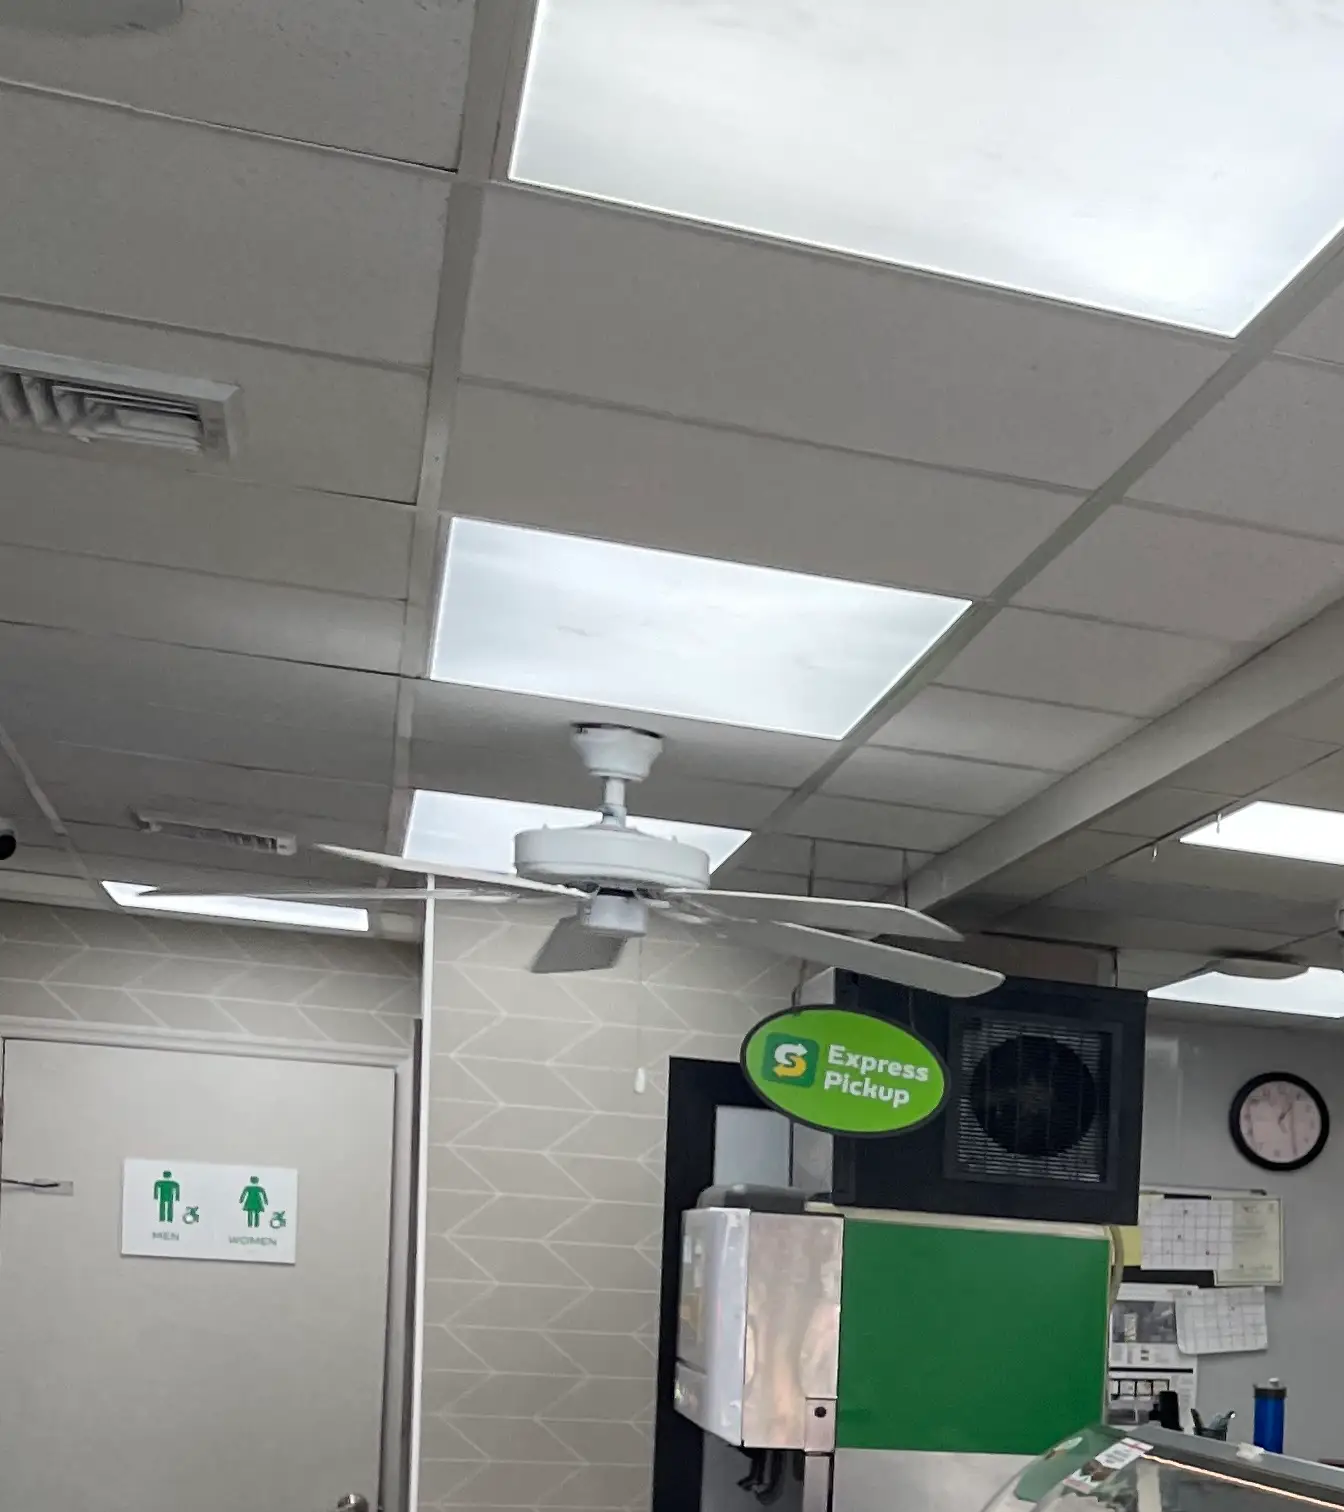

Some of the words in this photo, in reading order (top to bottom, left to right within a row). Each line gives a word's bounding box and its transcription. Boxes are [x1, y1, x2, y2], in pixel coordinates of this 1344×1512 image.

[827, 1044, 930, 1083] Express
[823, 1070, 911, 1109] Pickup
[151, 1231, 180, 1242] MEN
[228, 1235, 278, 1247] WOMEN
